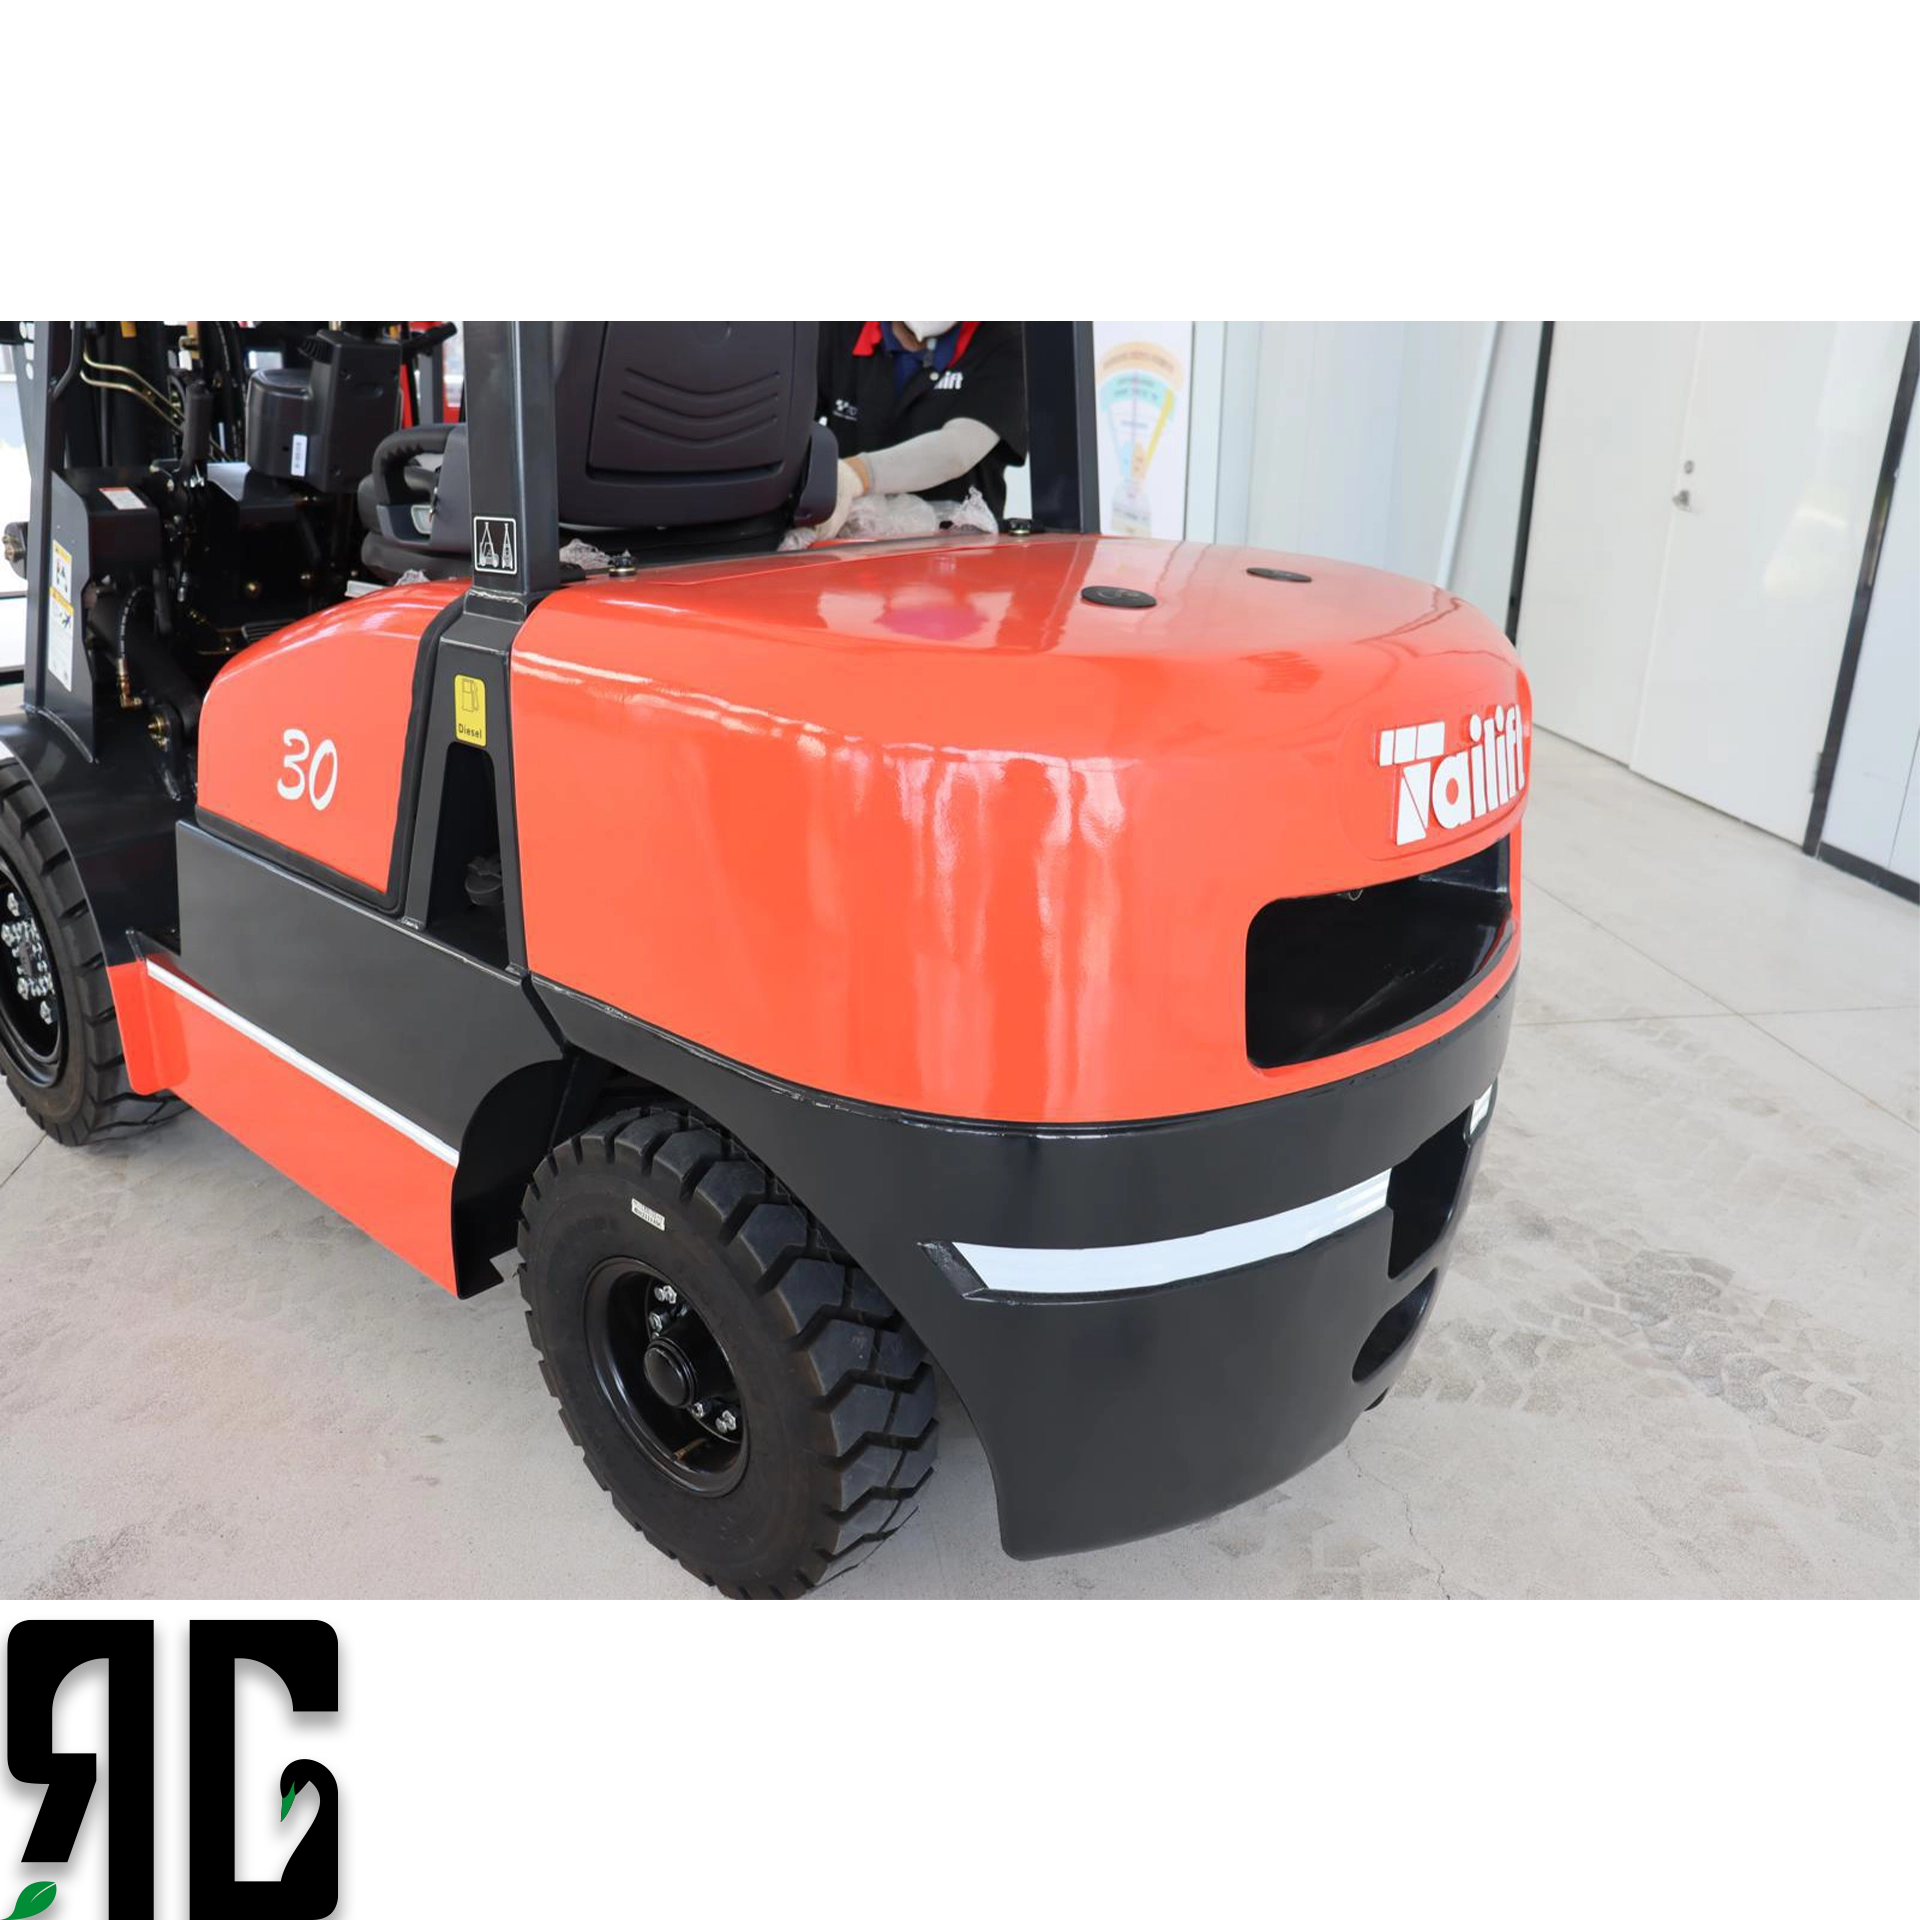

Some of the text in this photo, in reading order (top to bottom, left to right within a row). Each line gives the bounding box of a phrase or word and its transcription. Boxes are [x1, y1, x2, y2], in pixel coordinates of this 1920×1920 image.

[277, 728, 339, 811] 30
[457, 723, 483, 739] Diesel
[1379, 704, 1525, 846] Tailift
